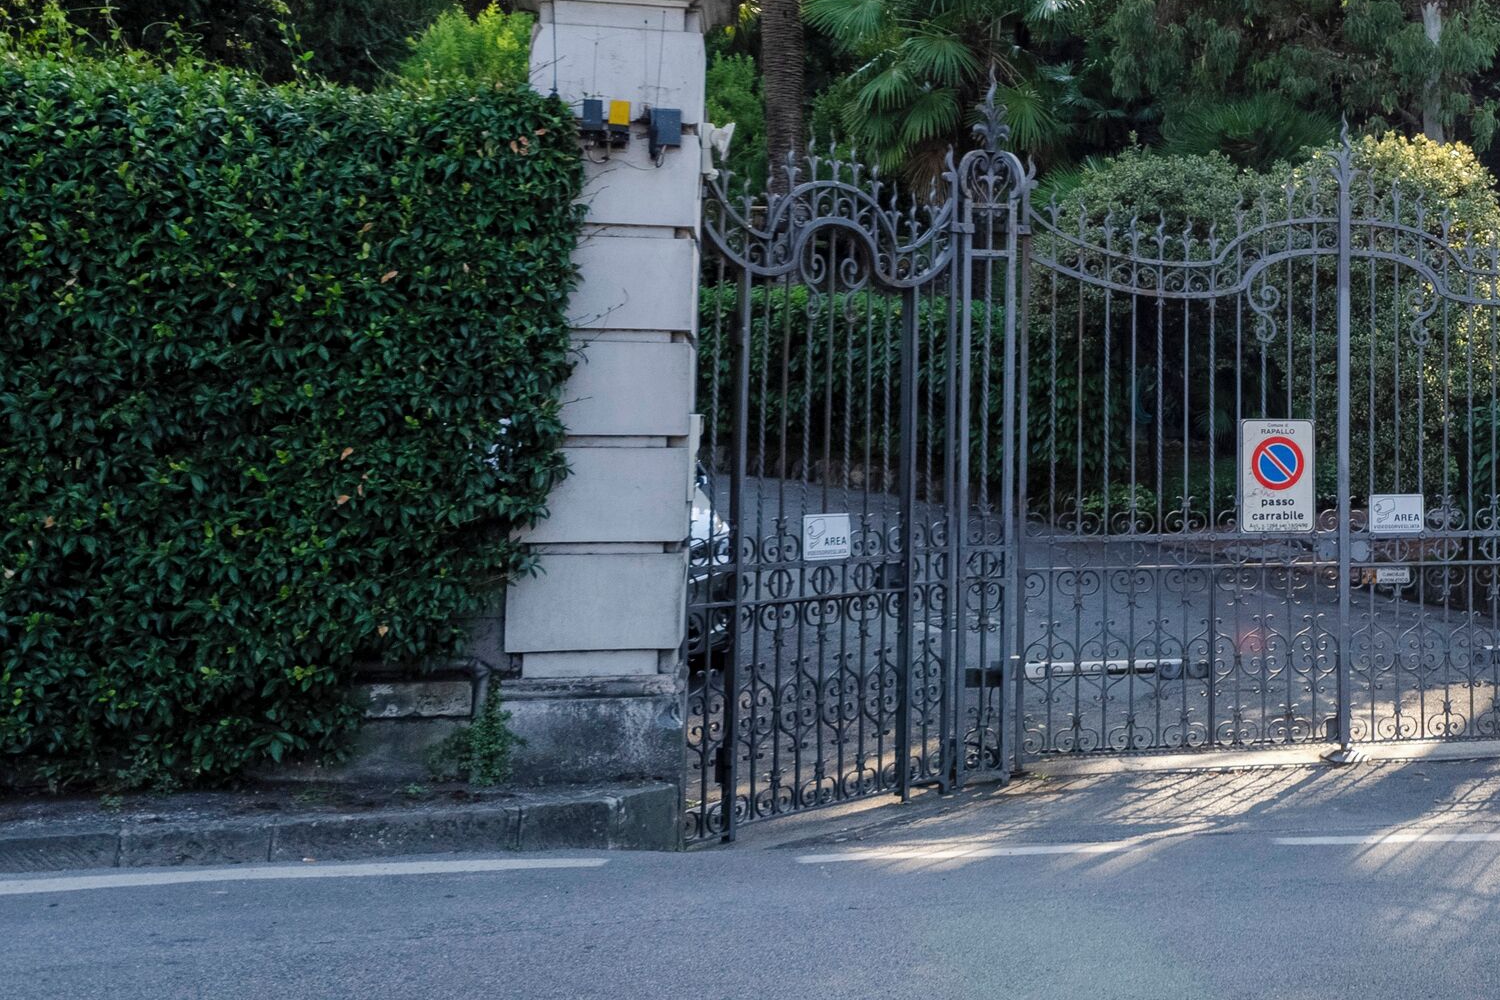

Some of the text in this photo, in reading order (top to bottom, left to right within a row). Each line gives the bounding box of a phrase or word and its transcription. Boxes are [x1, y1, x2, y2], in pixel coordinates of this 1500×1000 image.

[1261, 498, 1295, 508] passo
[1252, 510, 1304, 520] carrabile
[1394, 513, 1420, 521] AREA
[824, 536, 847, 546] AREA
